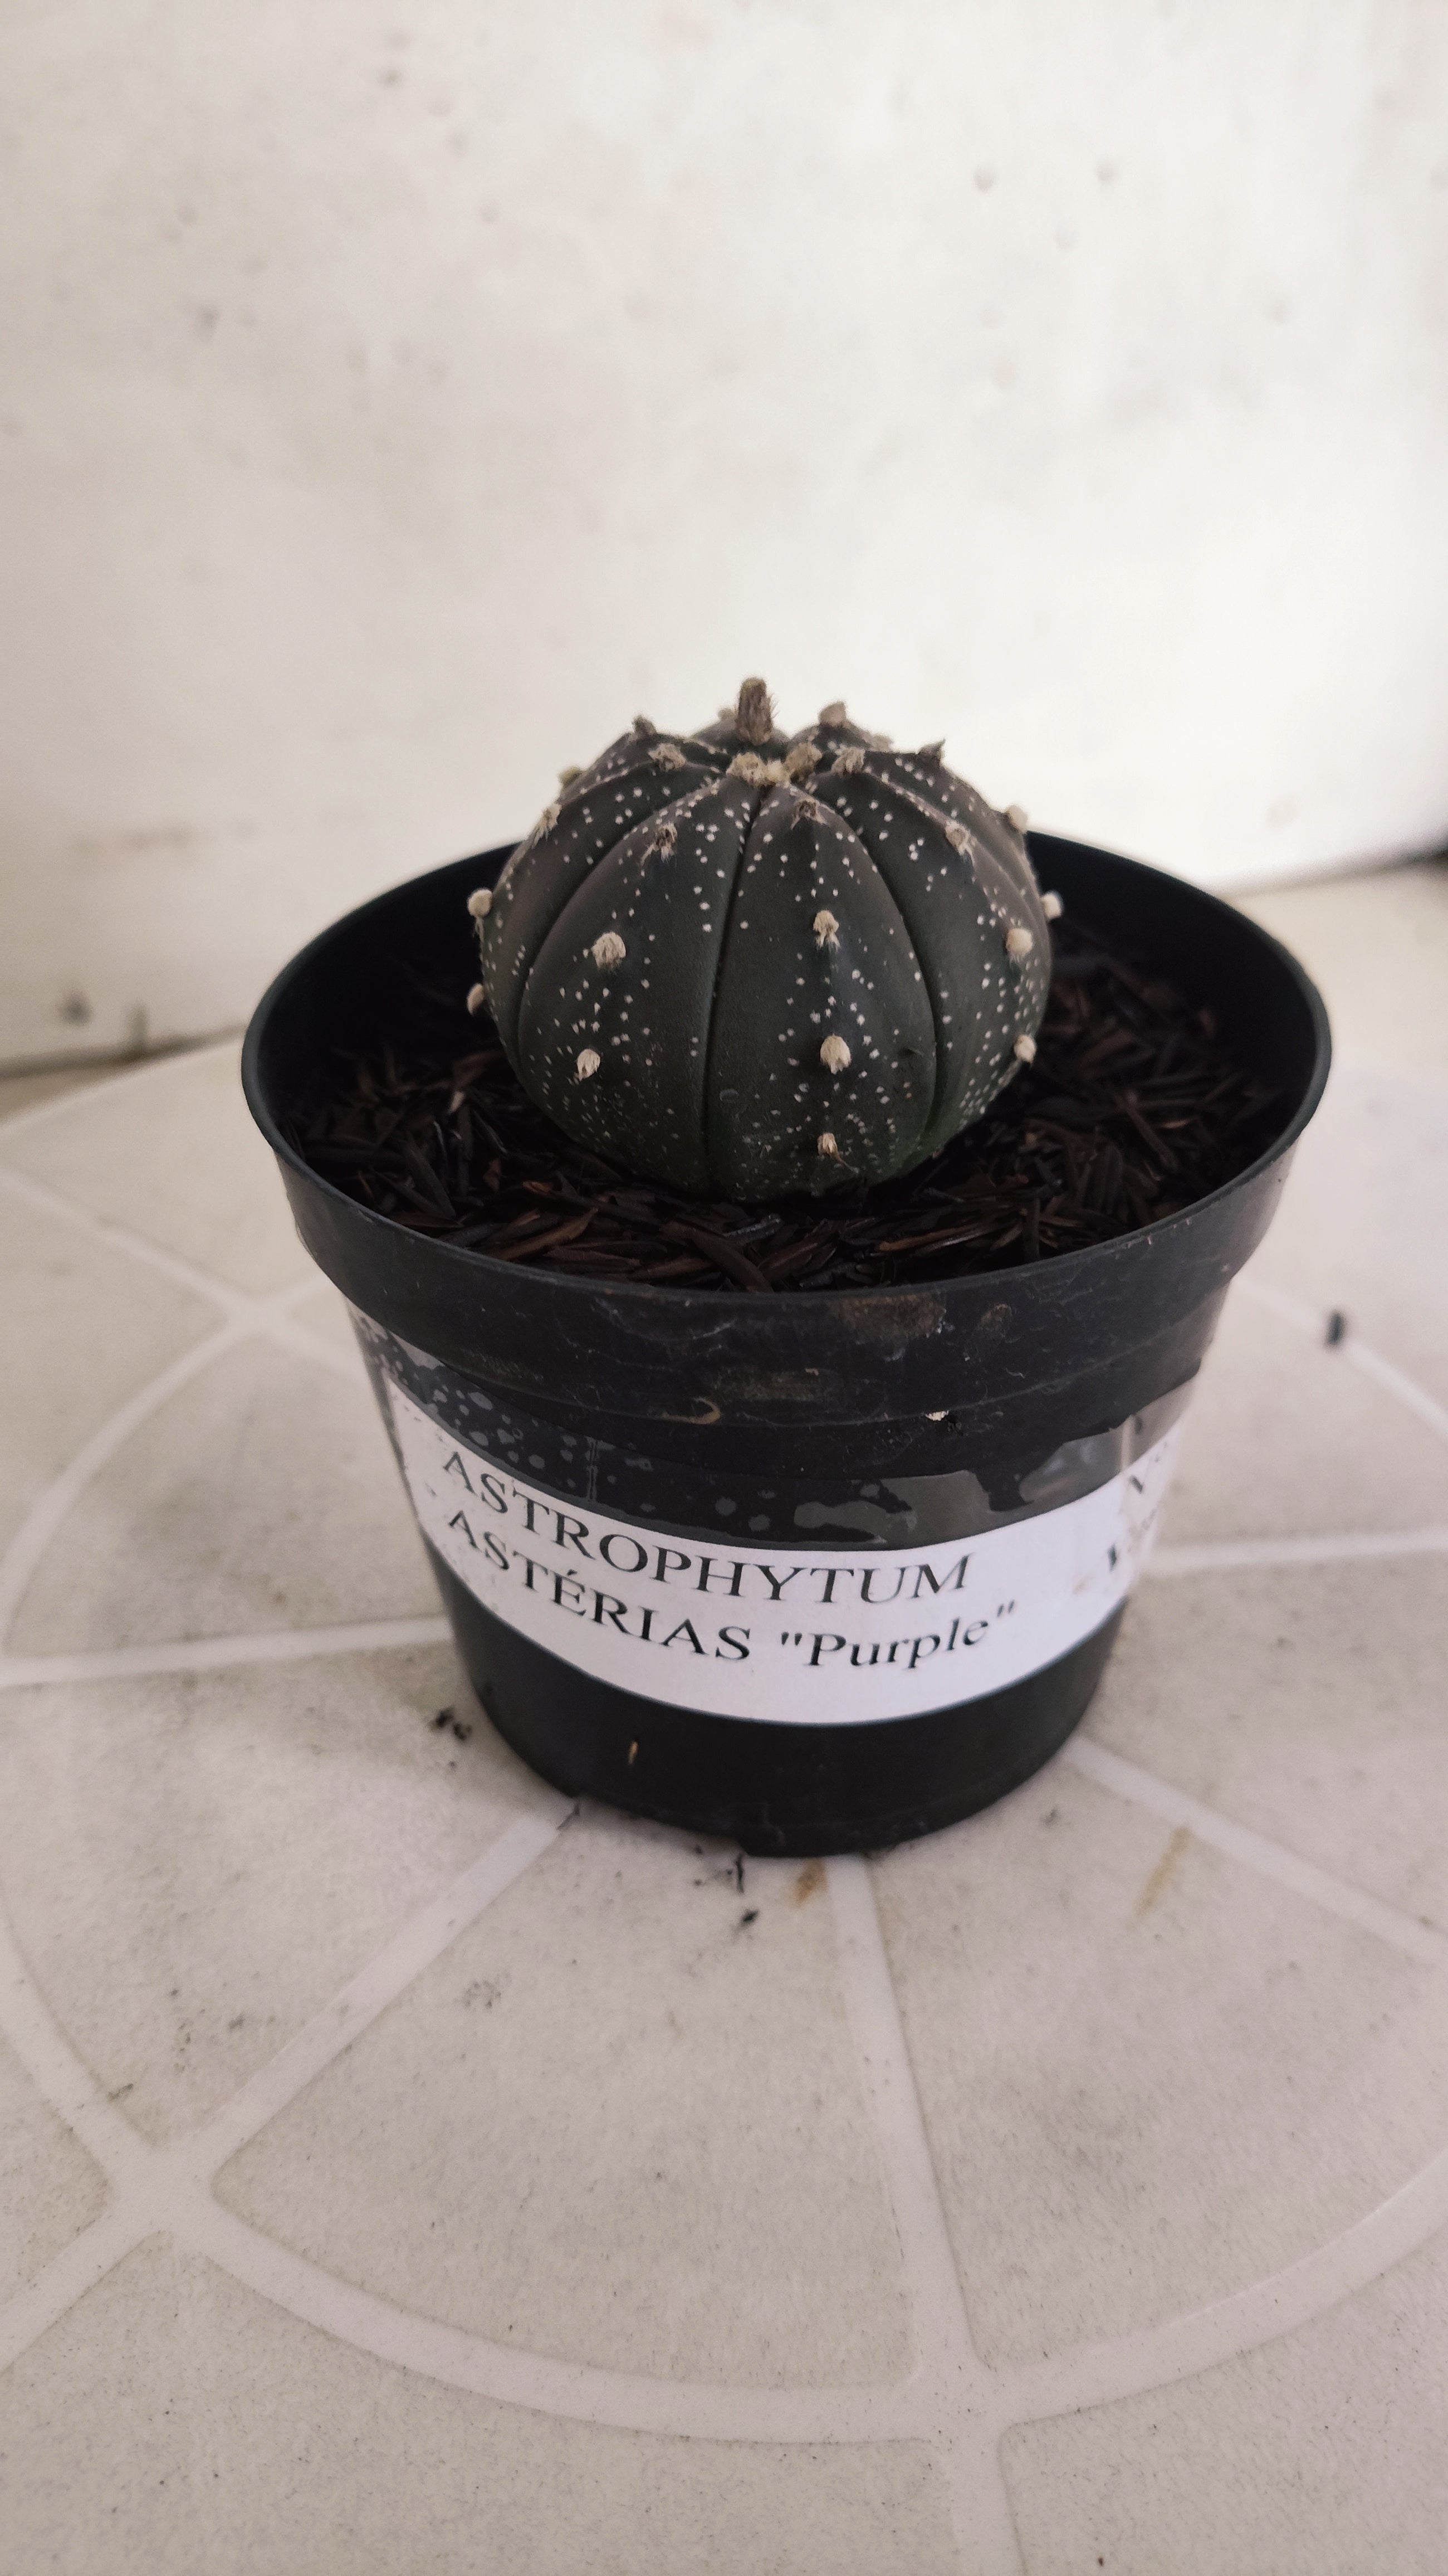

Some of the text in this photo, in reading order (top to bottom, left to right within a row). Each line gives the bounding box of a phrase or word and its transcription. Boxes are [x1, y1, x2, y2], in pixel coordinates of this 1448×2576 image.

[443, 1451, 974, 1604] ASTROPHYTUM
[448, 1510, 1015, 1670] ASTÉRIAS "Purple"
